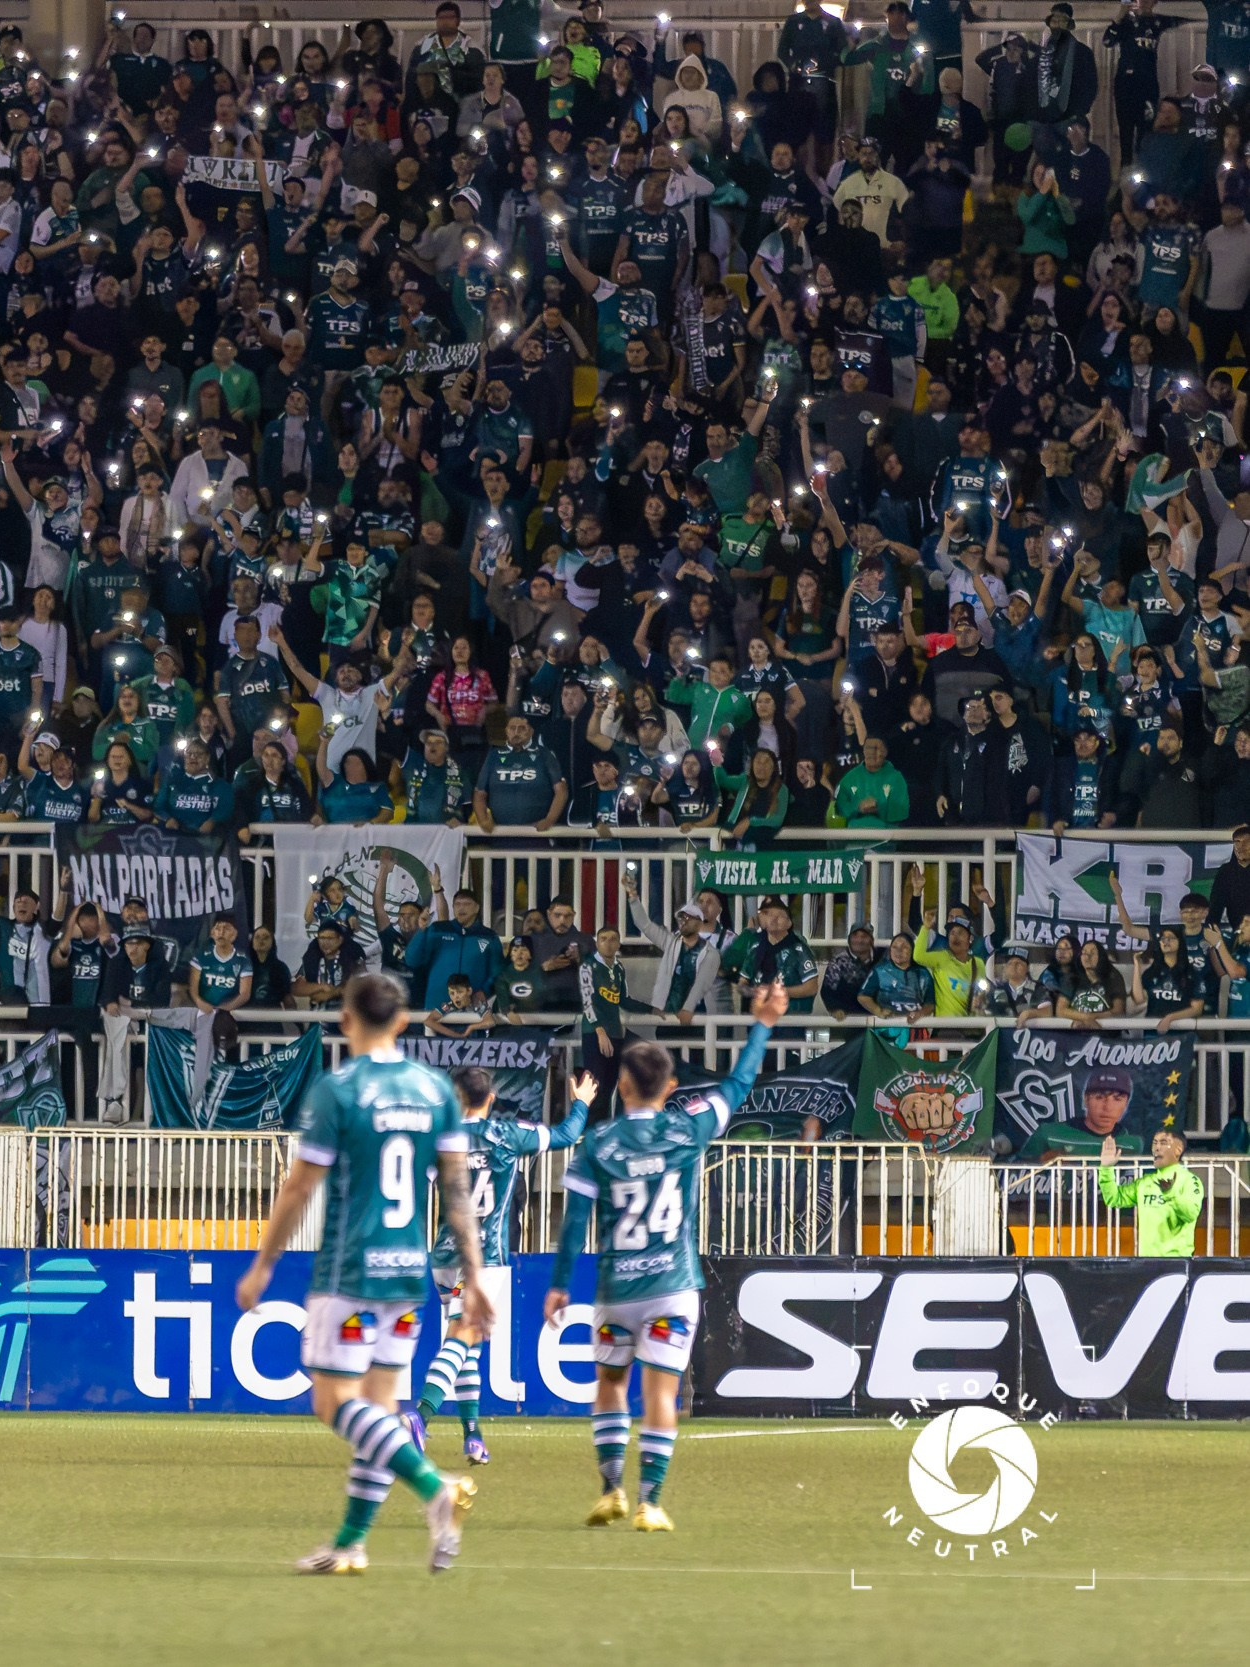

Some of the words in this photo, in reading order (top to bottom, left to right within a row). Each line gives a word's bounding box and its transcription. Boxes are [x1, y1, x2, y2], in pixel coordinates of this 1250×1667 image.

[584, 205, 617, 217] TPS
[635, 231, 670, 245] TPS
[1152, 242, 1182, 261] TPS
[619, 308, 649, 327] TPS
[326, 319, 361, 333] TPS
[838, 347, 872, 363] TPS
[951, 474, 985, 488] TPS
[726, 538, 762, 558] TPS
[449, 690, 480, 701] TPS
[1137, 716, 1163, 730] TPS
[496, 769, 538, 781] TPS
[714, 859, 757, 885] VISTA
[770, 861, 792, 885] AL
[807, 857, 844, 884] MAR
[69, 853, 235, 918] MALPORTADAS
[1015, 921, 1071, 944] MAS
[1078, 927, 1110, 949] DE
[74, 965, 100, 979] TPS
[205, 973, 236, 989] TPS
[1152, 989, 1182, 1001] TCL
[1013, 1029, 1057, 1066] Los
[1065, 1036, 1182, 1067] Aromos
[379, 1133, 416, 1230] 9
[1143, 1194, 1166, 1206] TPS
[613, 1170, 684, 1251] 24
